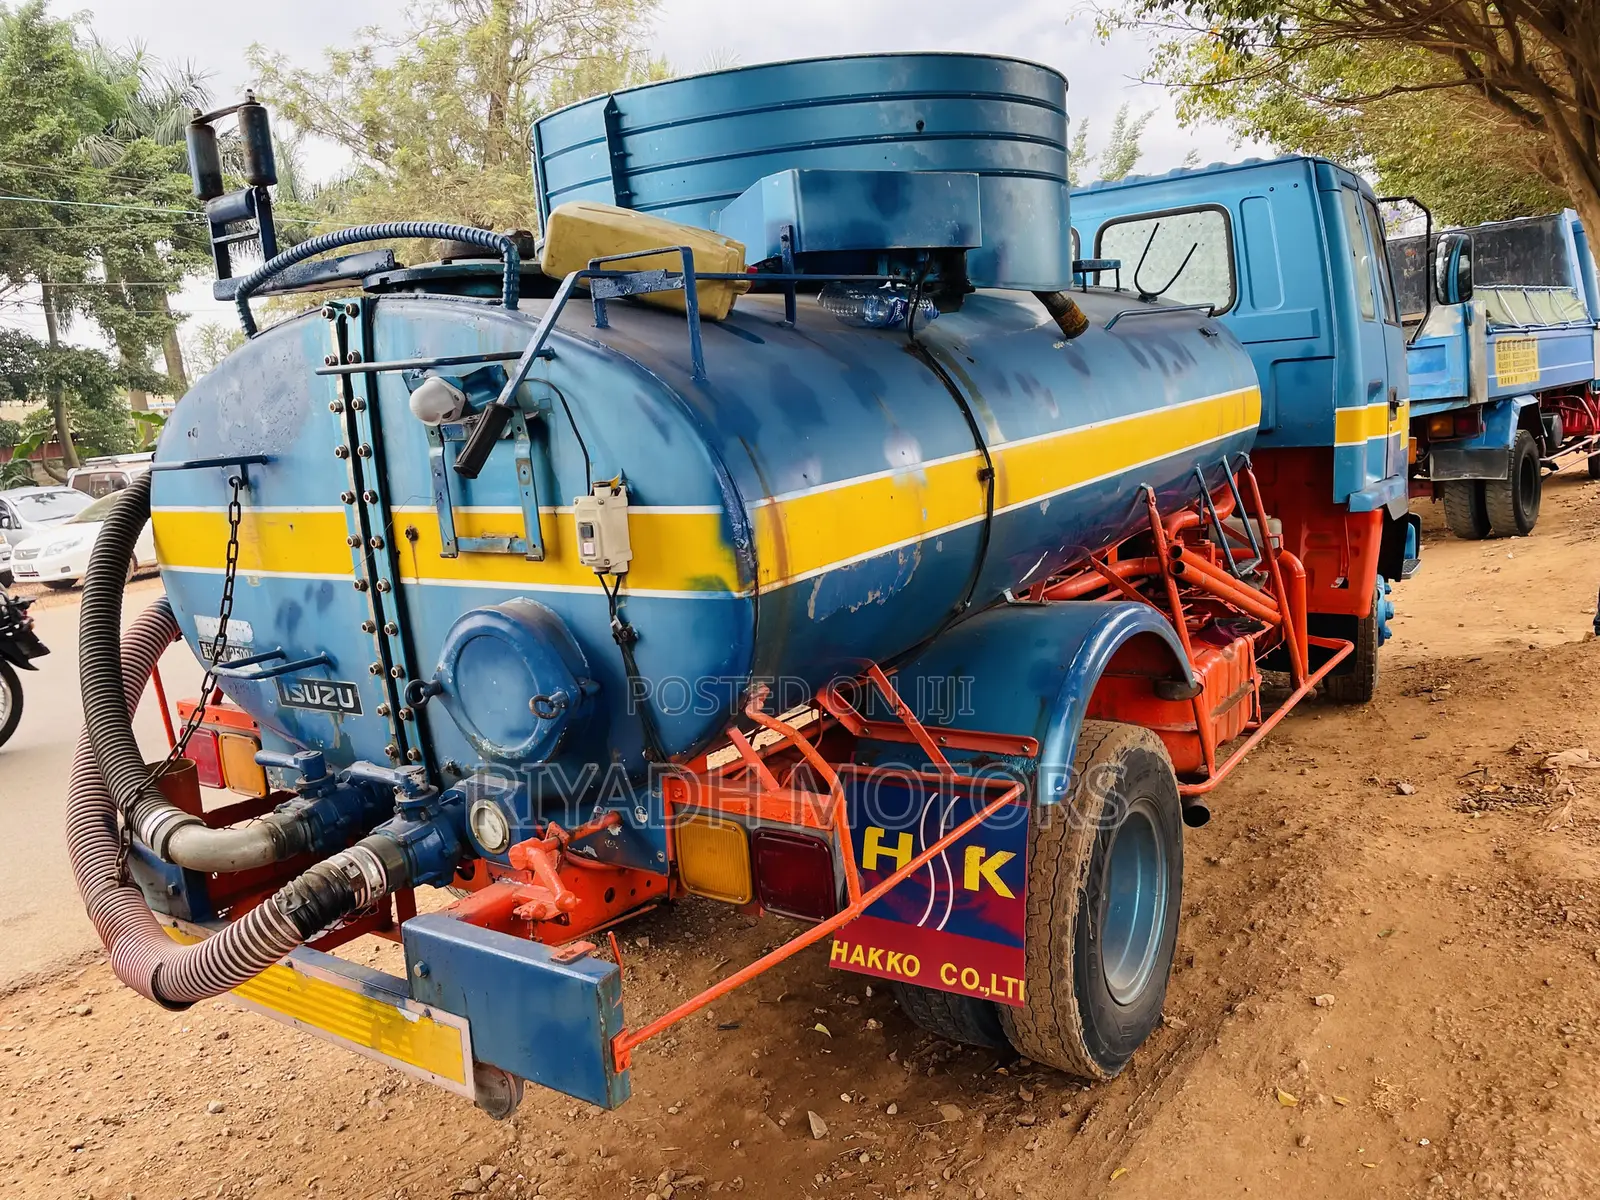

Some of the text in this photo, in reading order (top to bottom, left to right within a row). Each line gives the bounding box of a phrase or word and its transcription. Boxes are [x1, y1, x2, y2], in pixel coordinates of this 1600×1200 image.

[284, 683, 355, 708] ISUZU
[862, 826, 1017, 899] H K
[831, 940, 921, 977] HAKKO
